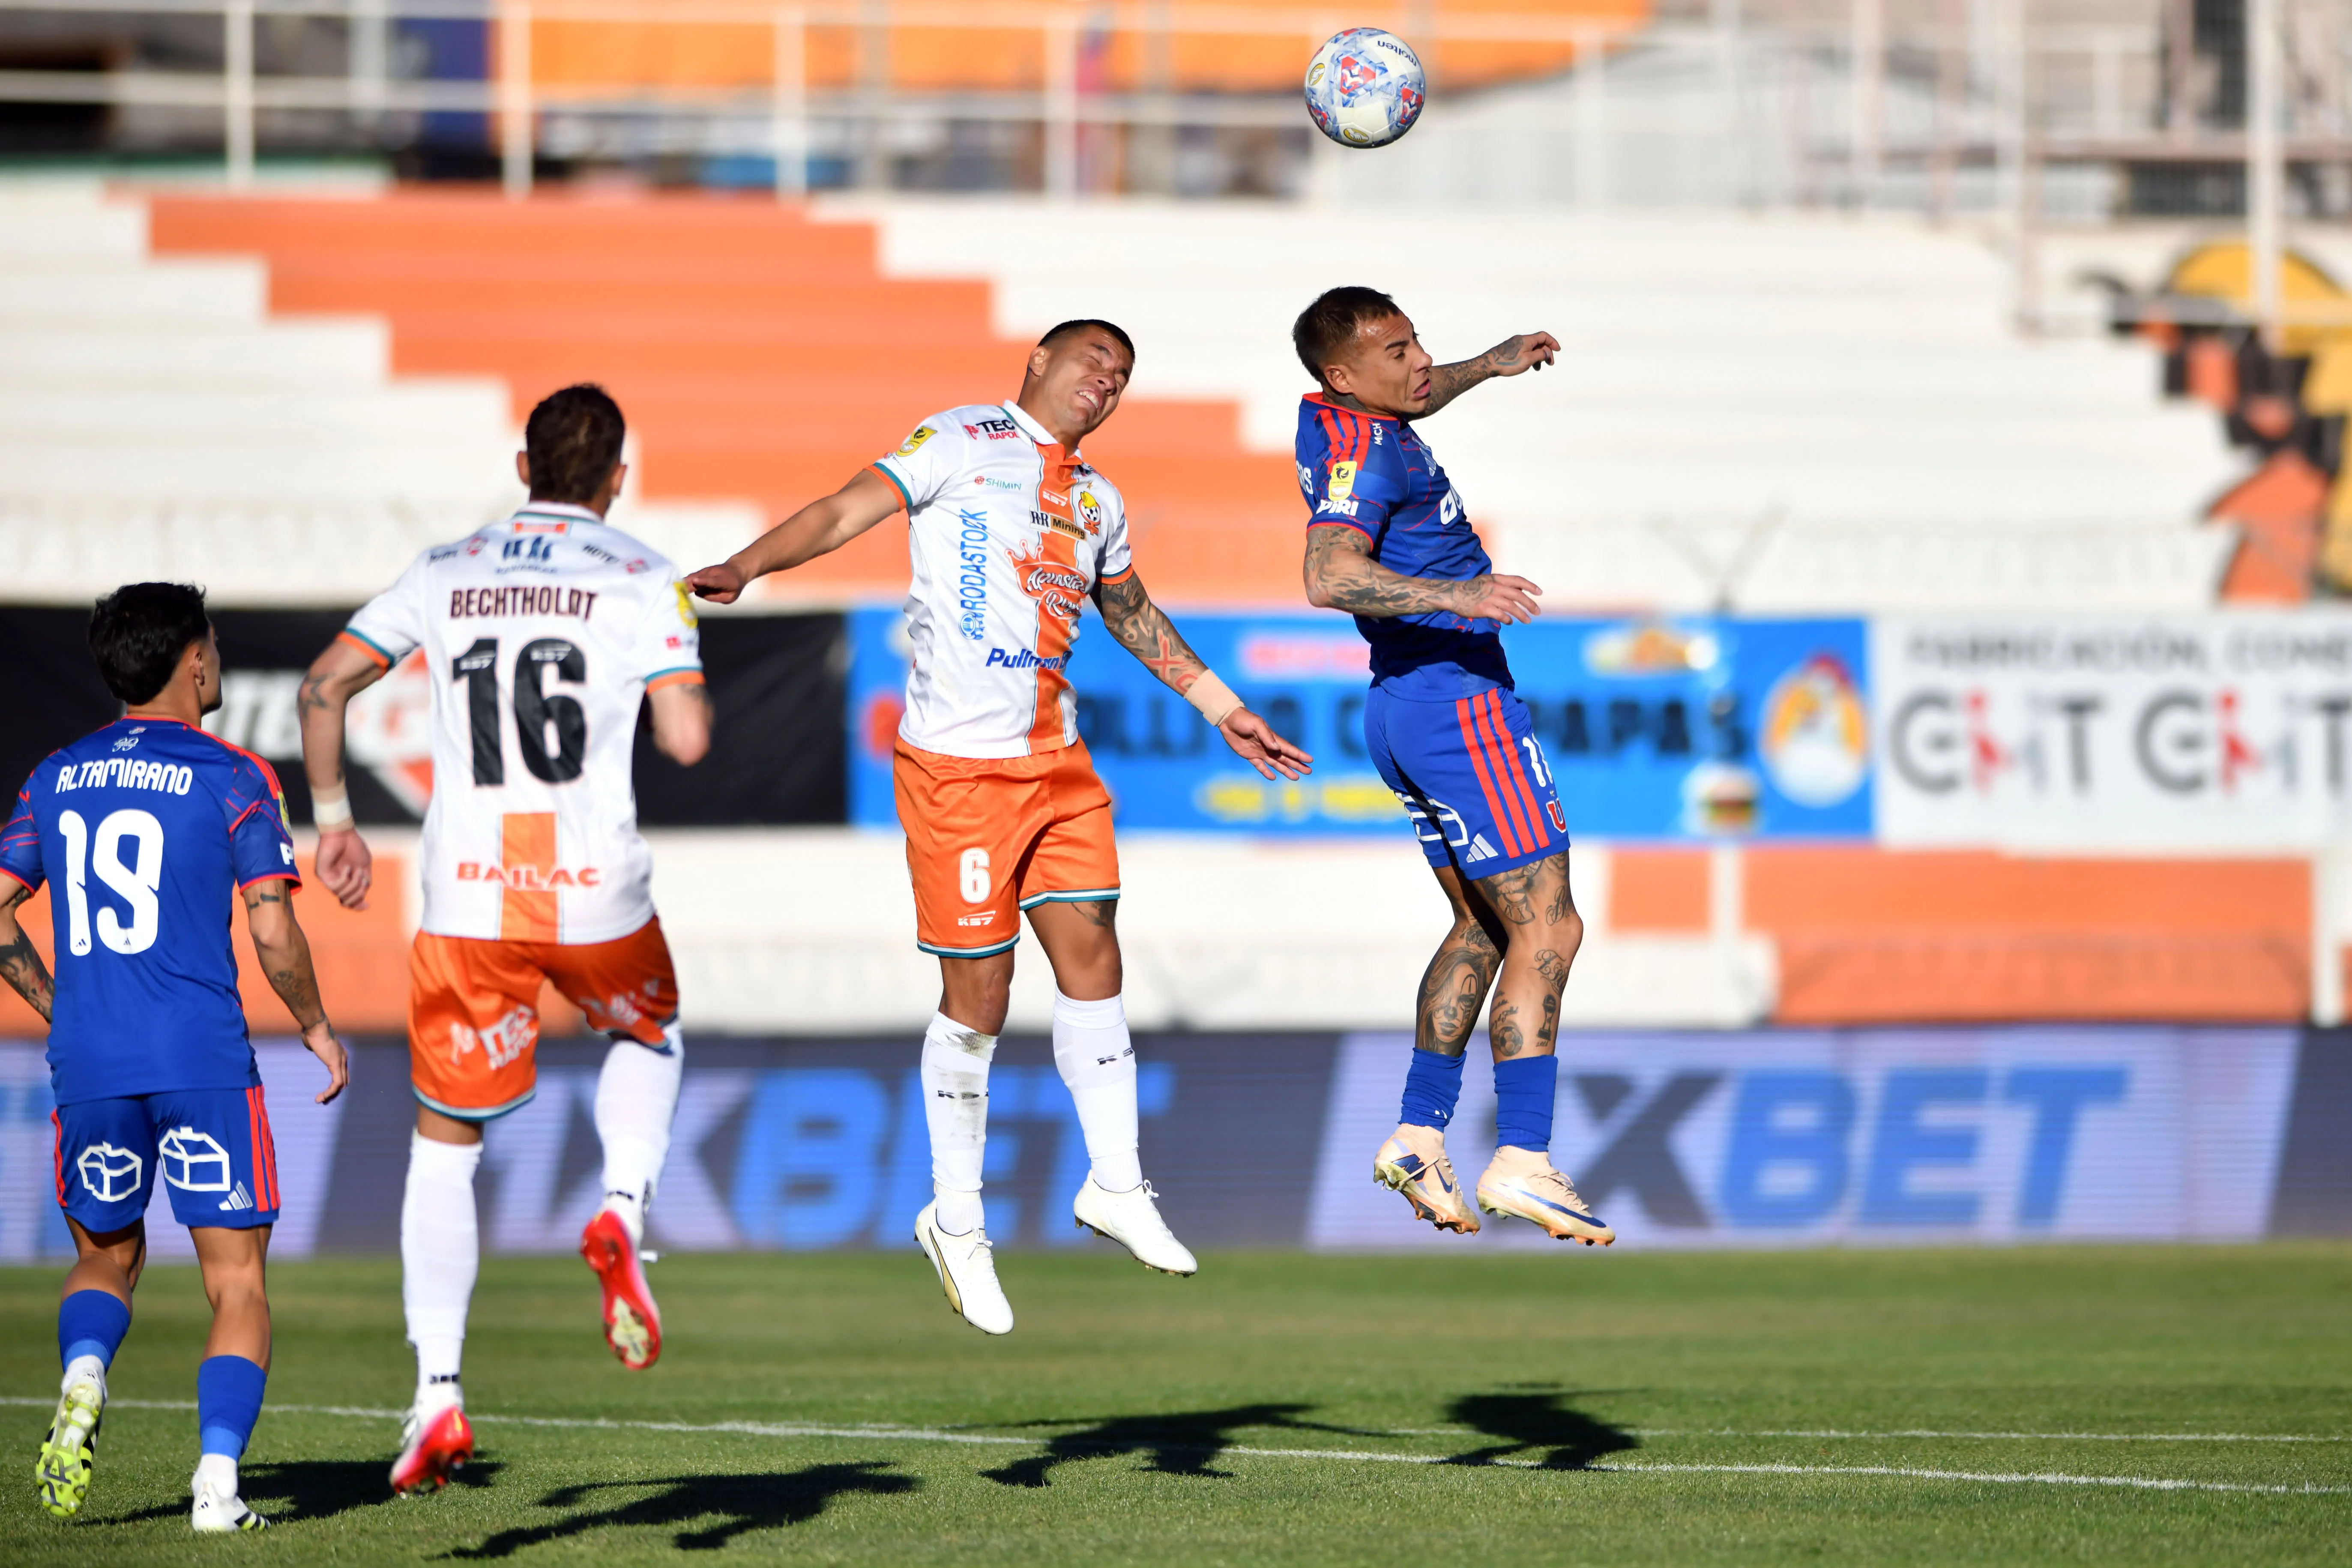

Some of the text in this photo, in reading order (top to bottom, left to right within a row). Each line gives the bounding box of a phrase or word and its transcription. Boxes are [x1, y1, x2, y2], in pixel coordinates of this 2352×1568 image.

[1377, 40, 1416, 67] molten
[986, 478, 1021, 491] SHIMIN
[1053, 518, 1085, 540] Mining
[960, 508, 987, 611] RODASTOCK
[450, 587, 598, 620] BECHTHOLDT
[986, 648, 1060, 670] Pullman
[452, 638, 586, 786] 16
[56, 758, 193, 796] ALTAMIRANO
[59, 808, 164, 956] 19
[457, 862, 601, 888] BAILAC
[959, 847, 991, 904] 6
[1482, 1069, 2129, 1230] XBET
